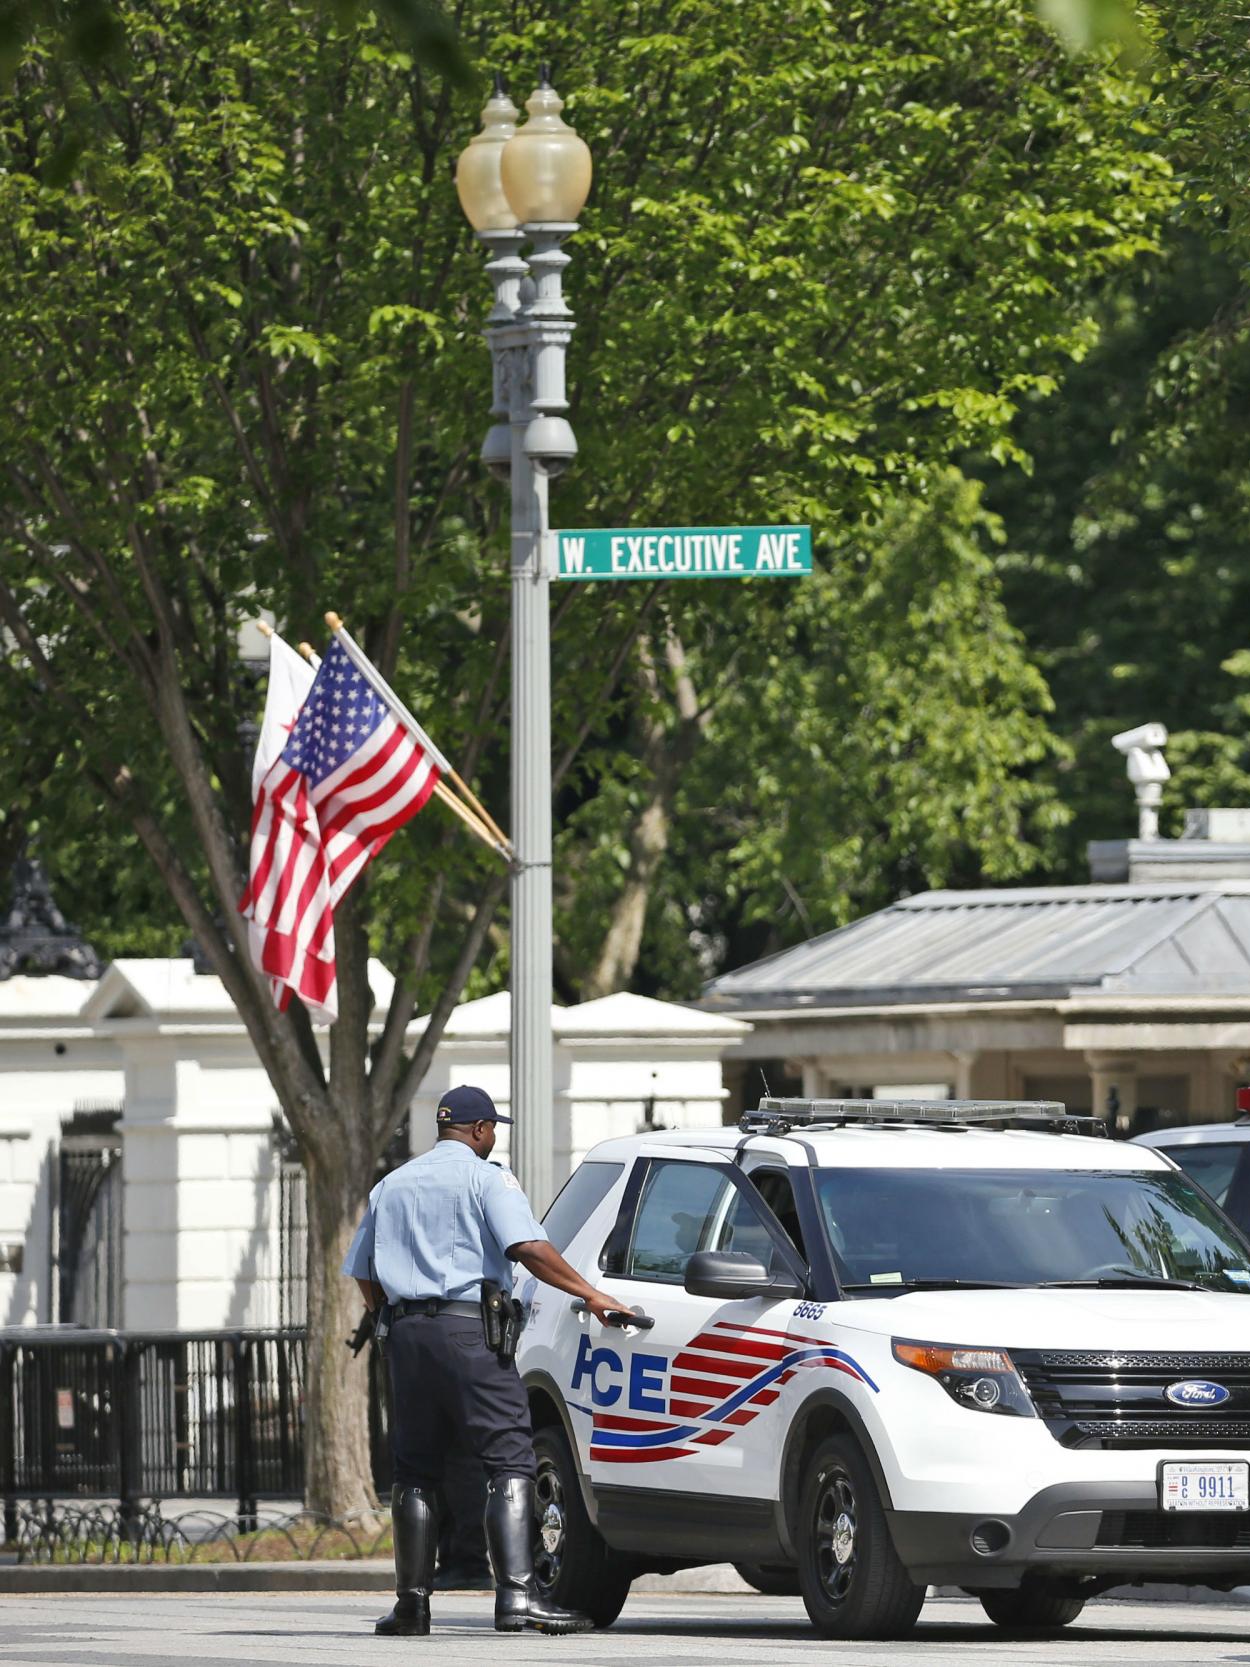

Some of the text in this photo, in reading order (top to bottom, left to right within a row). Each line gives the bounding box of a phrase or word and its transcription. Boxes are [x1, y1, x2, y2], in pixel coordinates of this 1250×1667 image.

[562, 533, 802, 573] W. EXECUTIVE AVE
[793, 1302, 827, 1320] 8665
[1182, 1383, 1216, 1400] Ford
[1199, 1476, 1235, 1498] 9911
